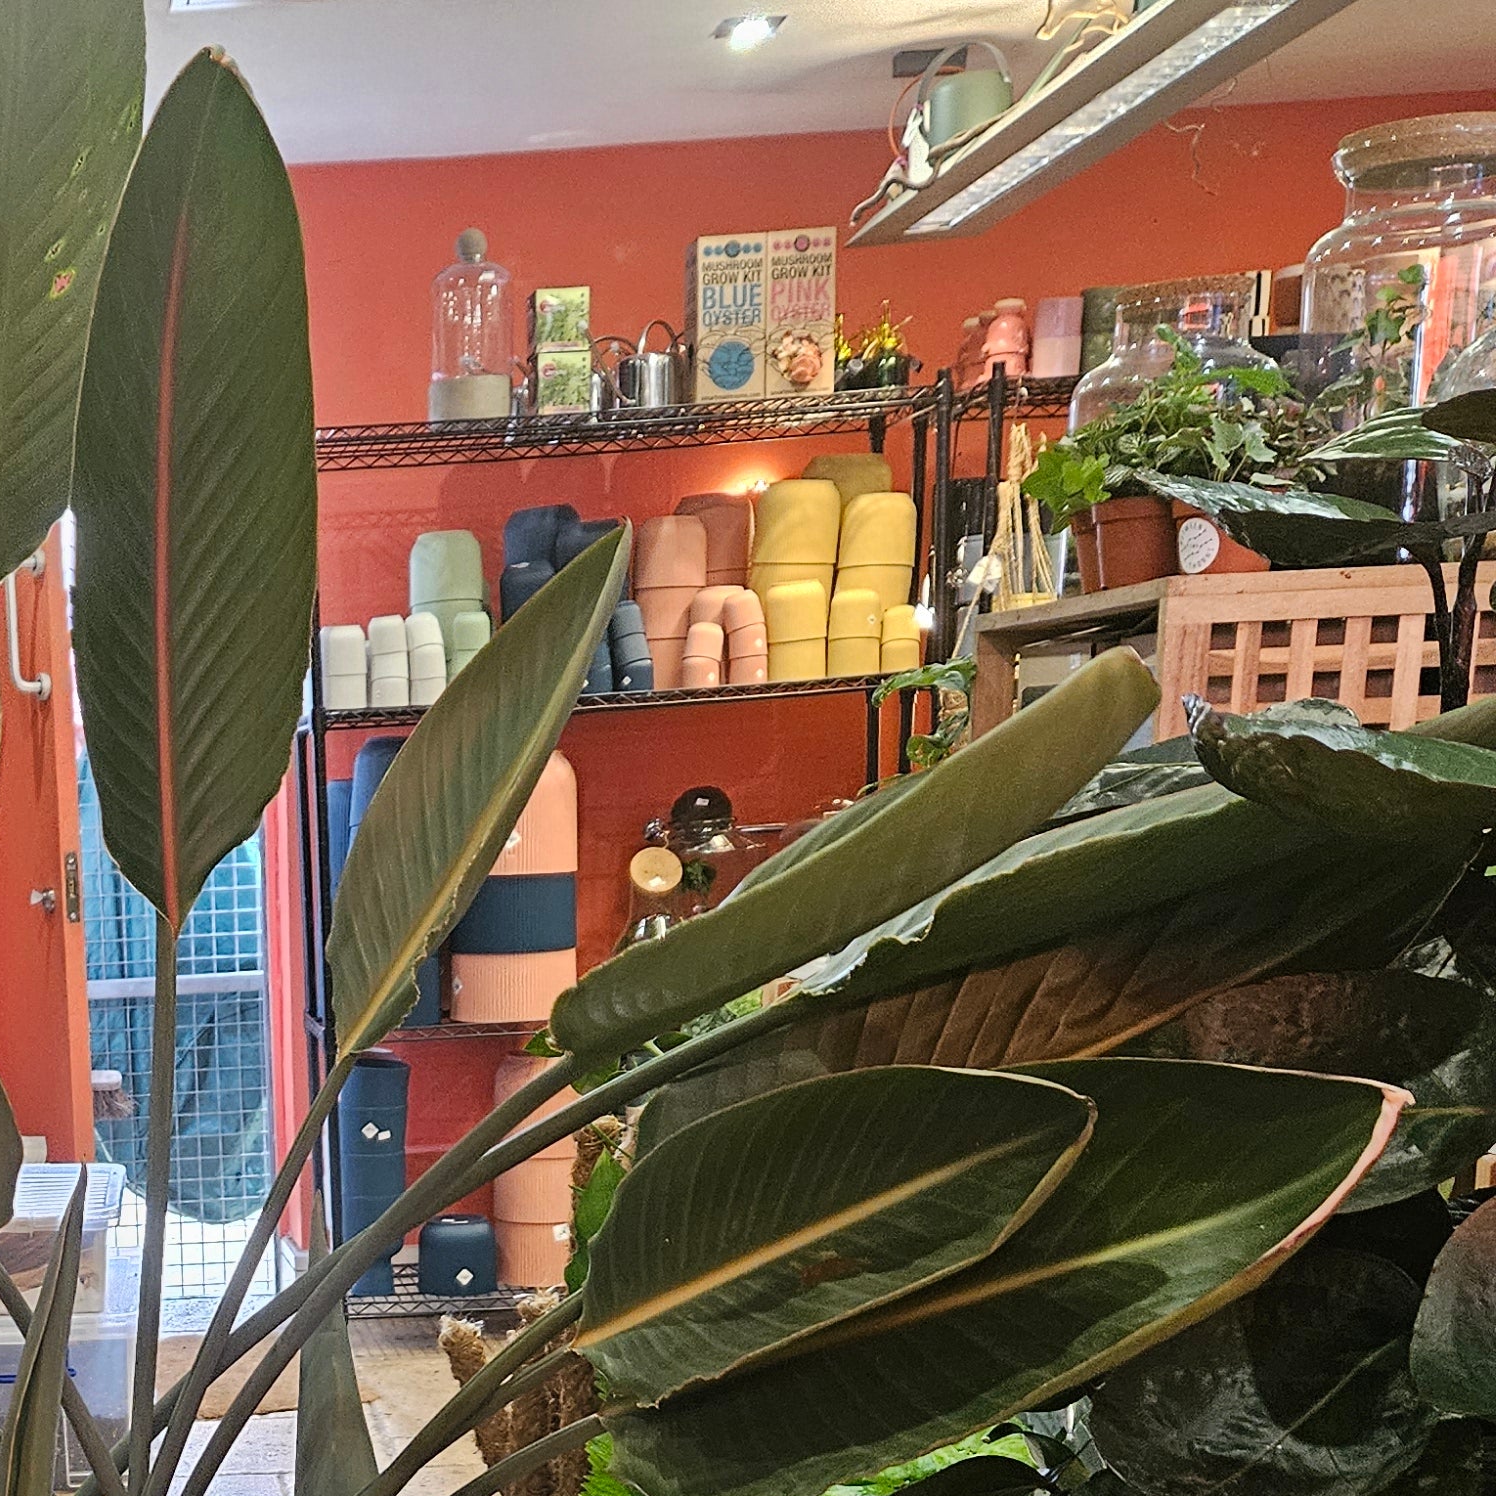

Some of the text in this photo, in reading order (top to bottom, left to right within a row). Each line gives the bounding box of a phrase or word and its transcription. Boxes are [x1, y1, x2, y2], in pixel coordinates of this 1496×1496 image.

[702, 258, 763, 272] MUSHROOM
[771, 252, 833, 266] MUSHROOM
[702, 269, 762, 285] GROW KIT
[771, 264, 831, 280] GROW KIT
[702, 283, 762, 310] BLUE
[771, 278, 830, 304] PINK
[702, 308, 762, 327] OYSTER
[771, 302, 831, 322] OYSTER
